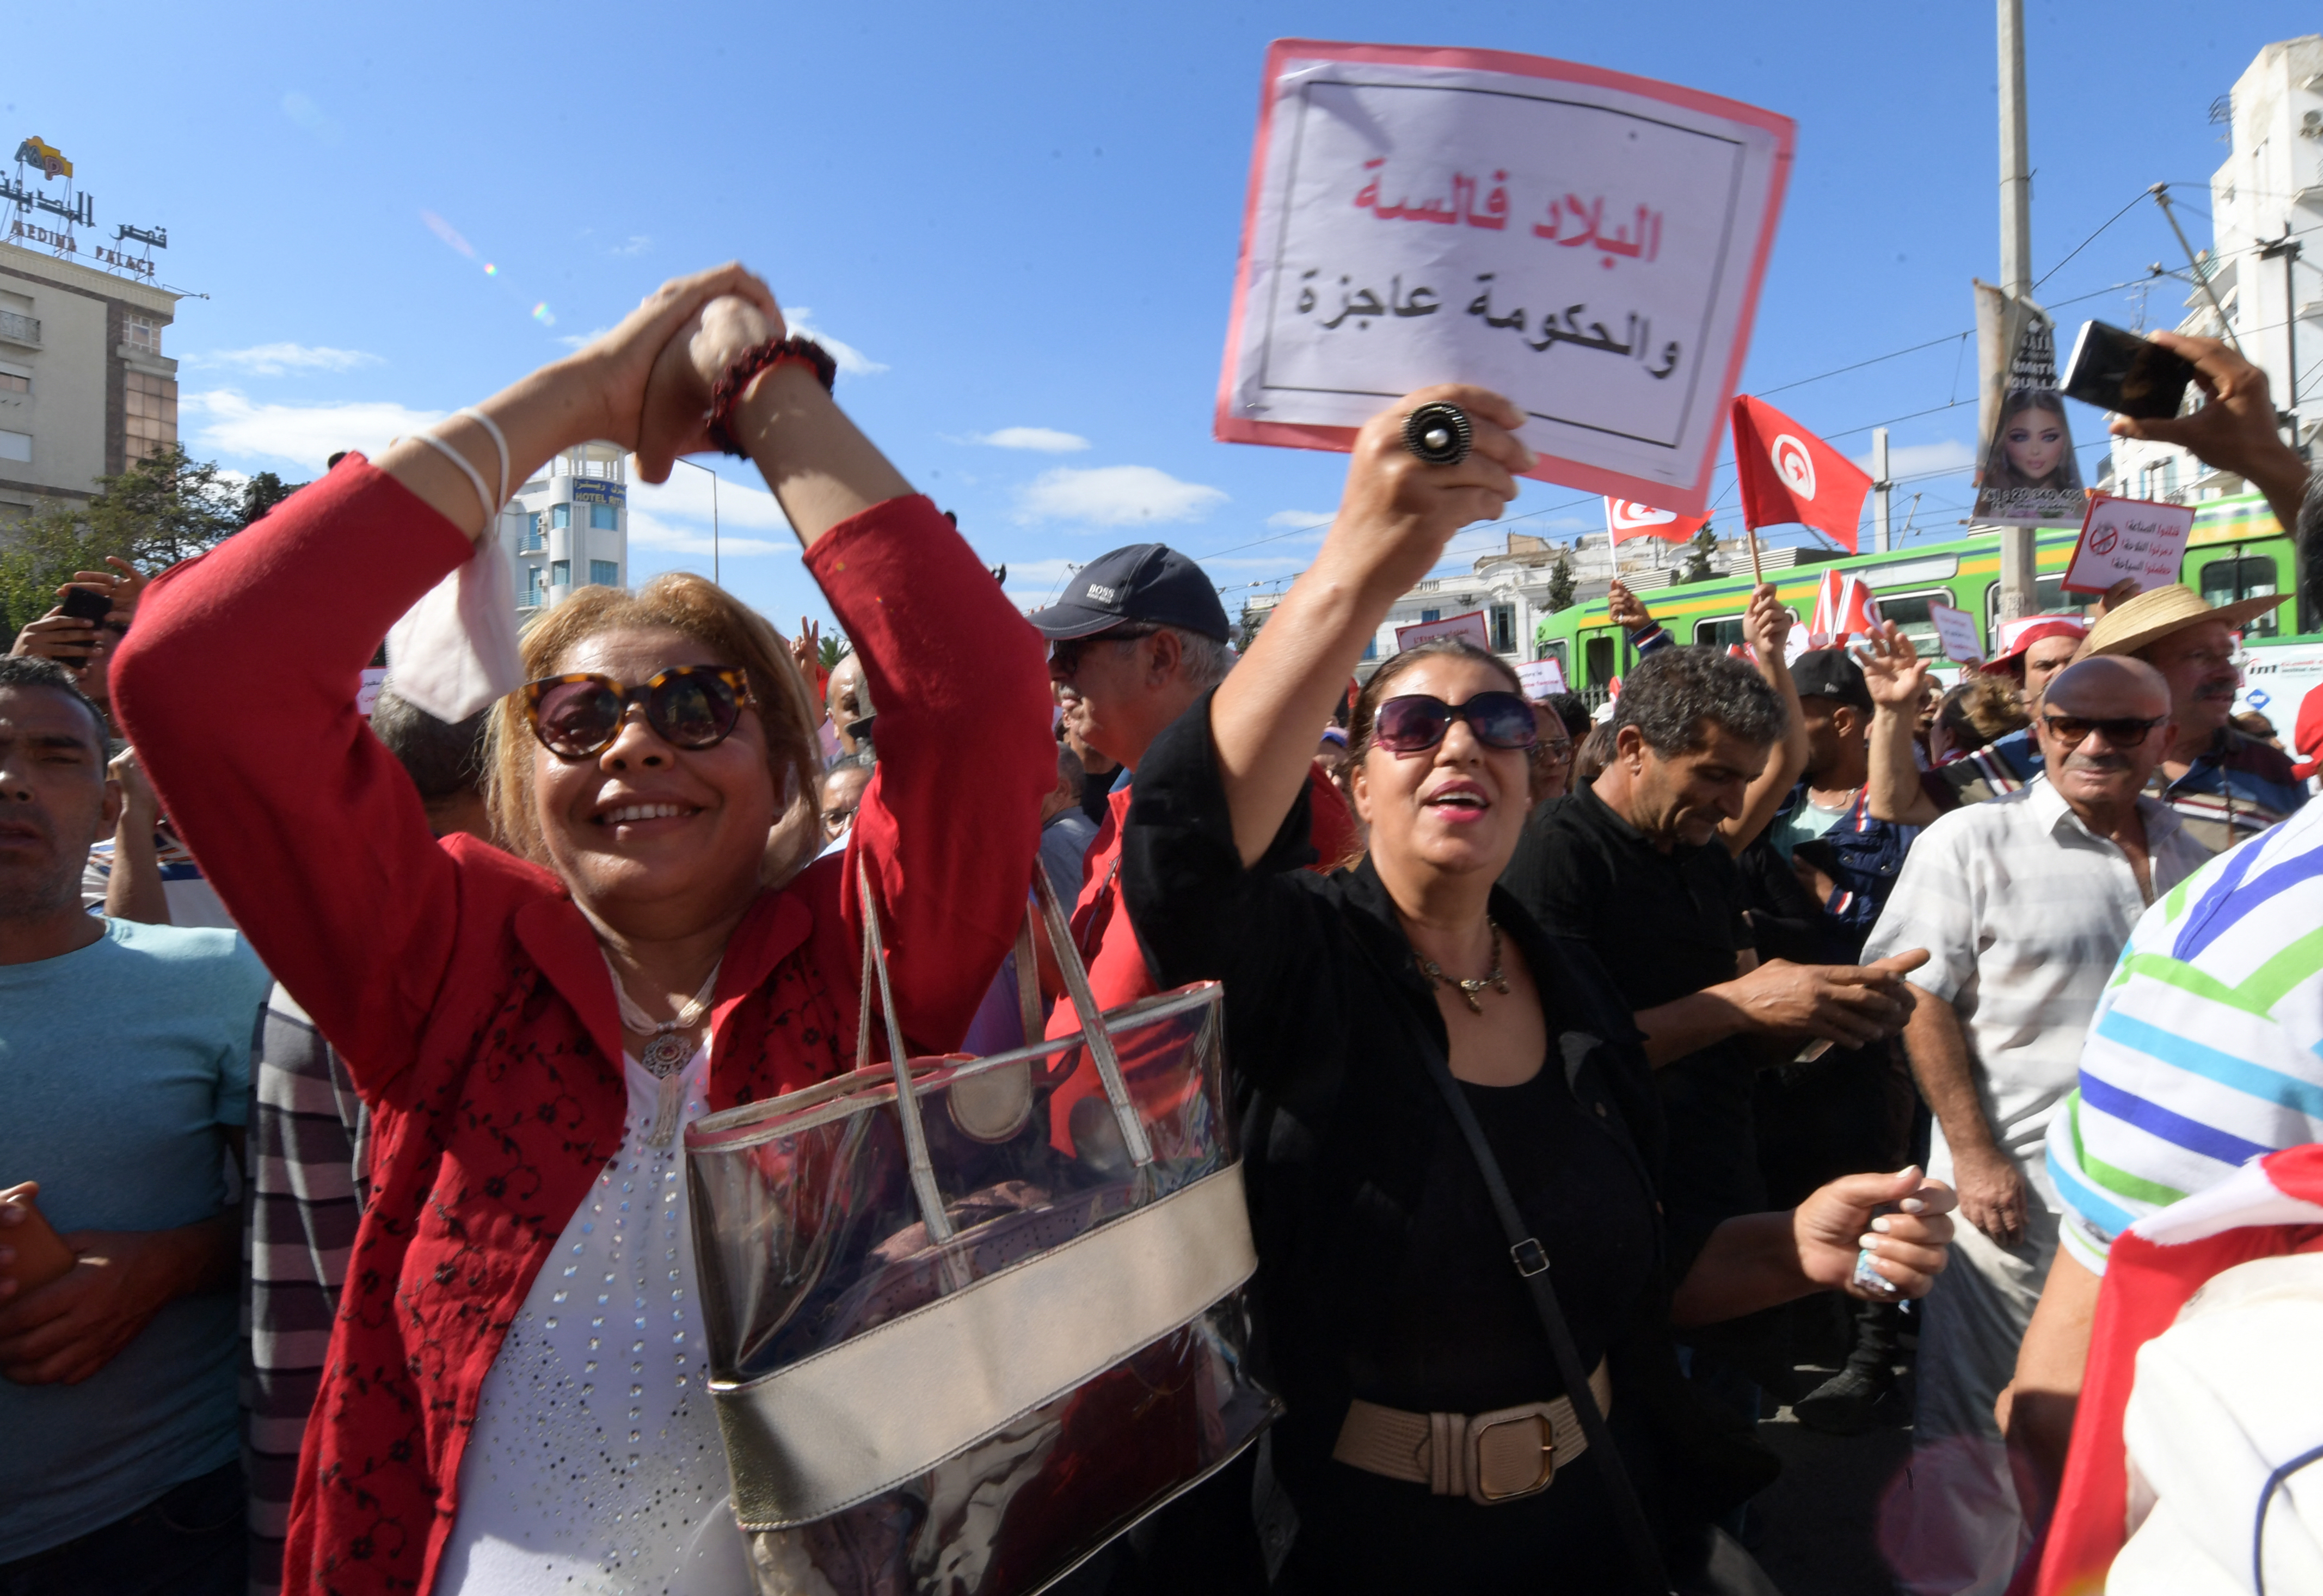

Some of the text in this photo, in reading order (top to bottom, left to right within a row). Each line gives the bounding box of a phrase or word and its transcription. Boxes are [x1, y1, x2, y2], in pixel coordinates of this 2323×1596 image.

[1355, 157, 1662, 271] البلاد فالسة
[10, 219, 155, 276] MEDINA PALACE
[1296, 268, 1682, 380] والحكومة عاجزة
[576, 492, 606, 504] HOTEL
[1087, 583, 1115, 598] BOSS
